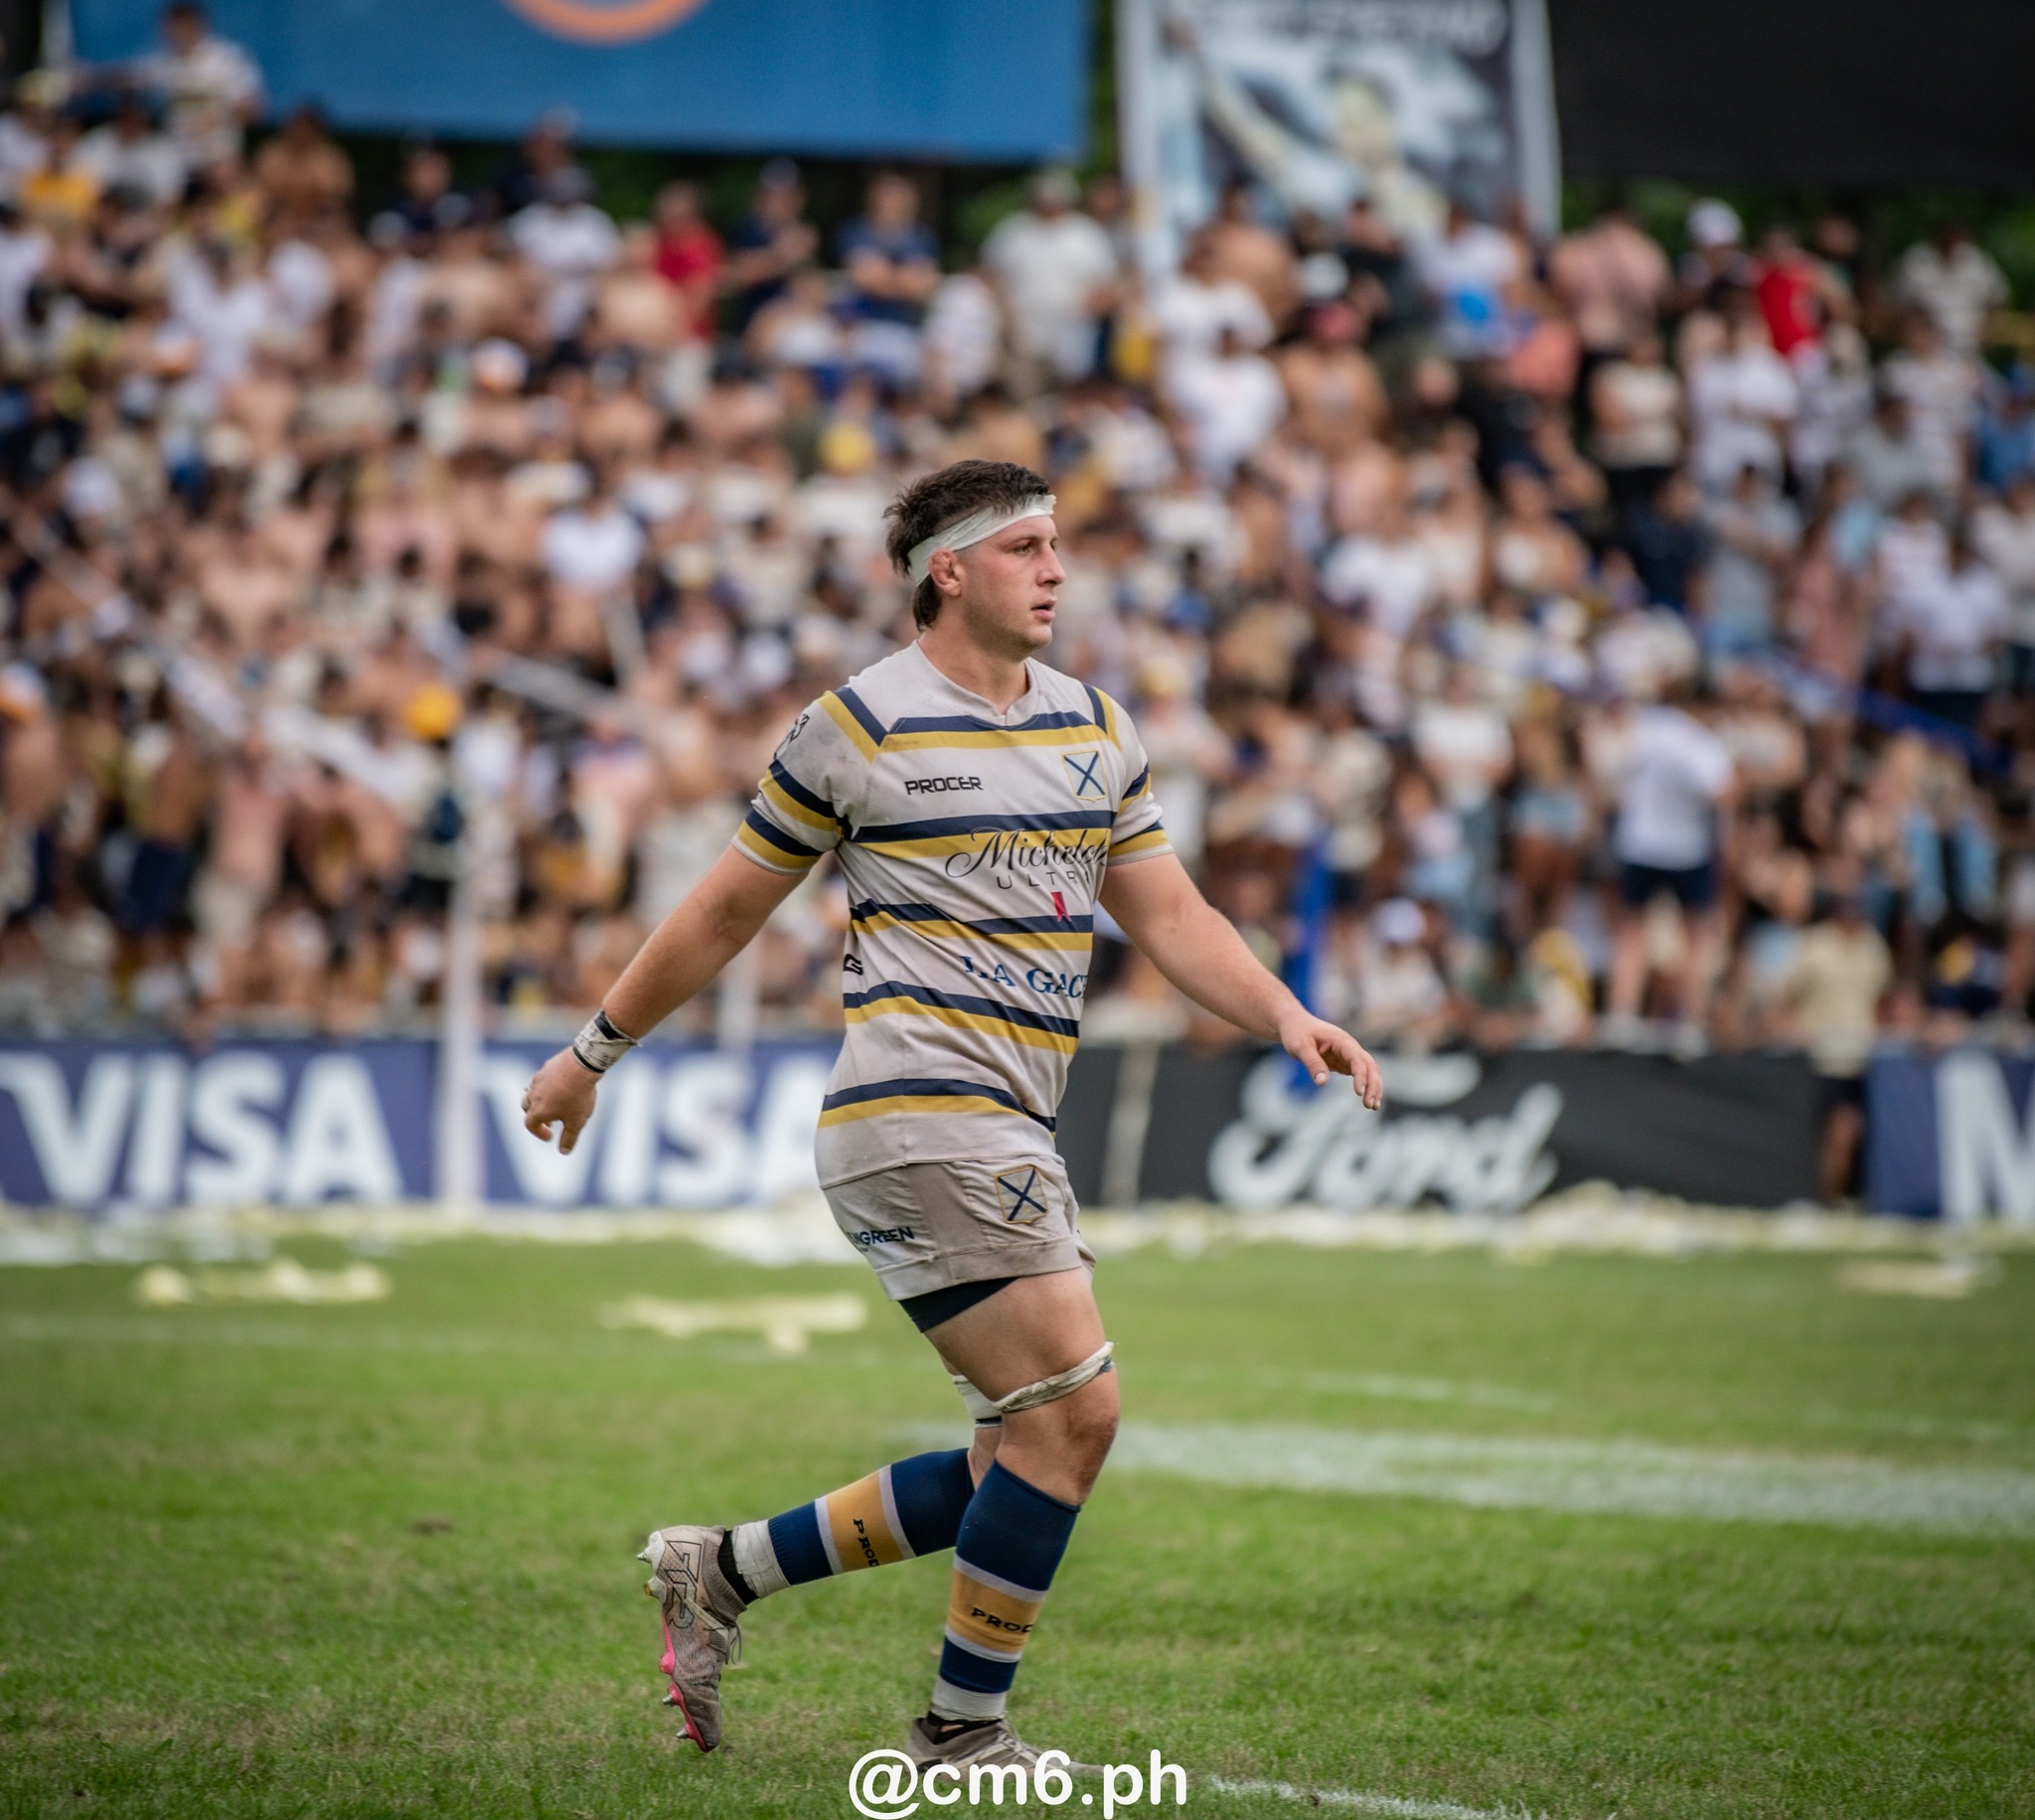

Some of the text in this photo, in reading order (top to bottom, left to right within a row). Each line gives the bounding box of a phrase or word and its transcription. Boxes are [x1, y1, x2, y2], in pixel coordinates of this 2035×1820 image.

[904, 776, 984, 795] PROCER
[1025, 969, 1088, 997] GAC
[0, 1051, 405, 1207] VISA
[1208, 1050, 1560, 1210] Ford
